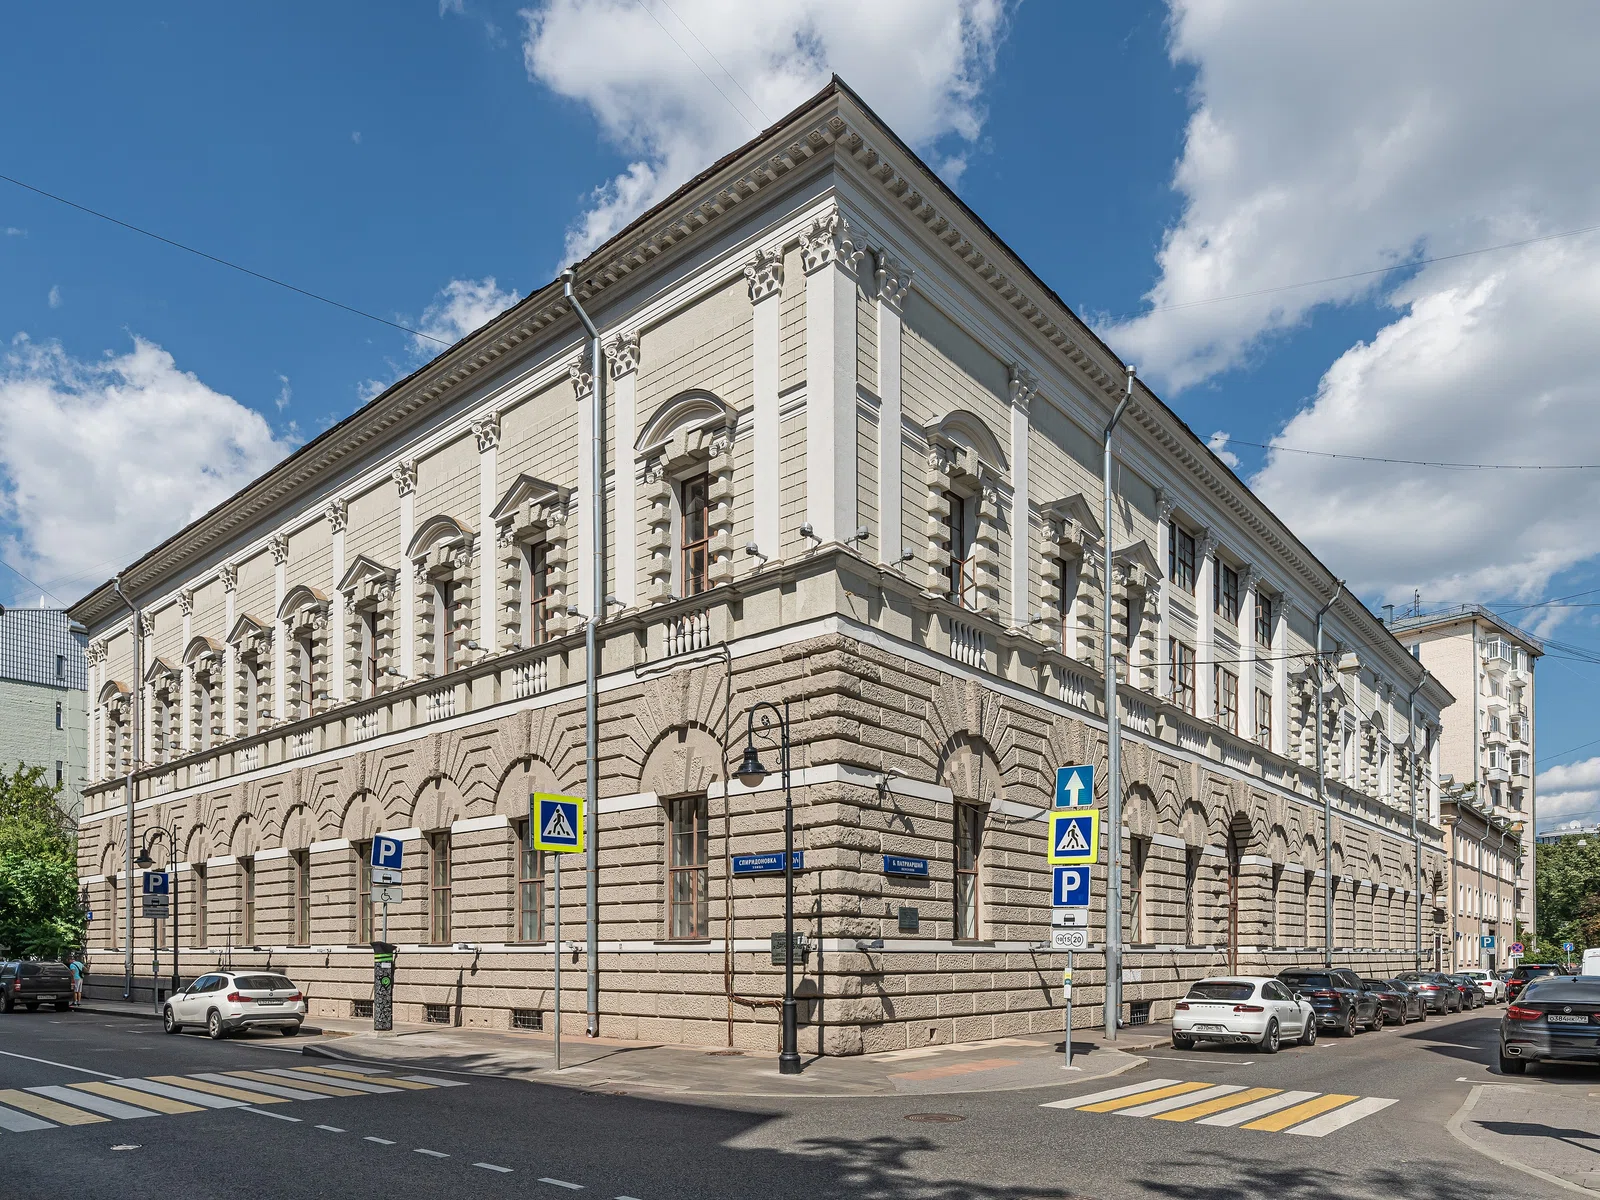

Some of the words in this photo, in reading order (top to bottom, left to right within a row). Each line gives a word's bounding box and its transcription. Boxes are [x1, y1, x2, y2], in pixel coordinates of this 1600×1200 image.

[379, 839, 396, 865] P
[738, 857, 777, 866] СПИРИДОНОВКА
[897, 860, 924, 868] ПАТРИАРШИЙ
[149, 874, 163, 892] P
[1061, 870, 1081, 903] P
[1483, 937, 1491, 947] P
